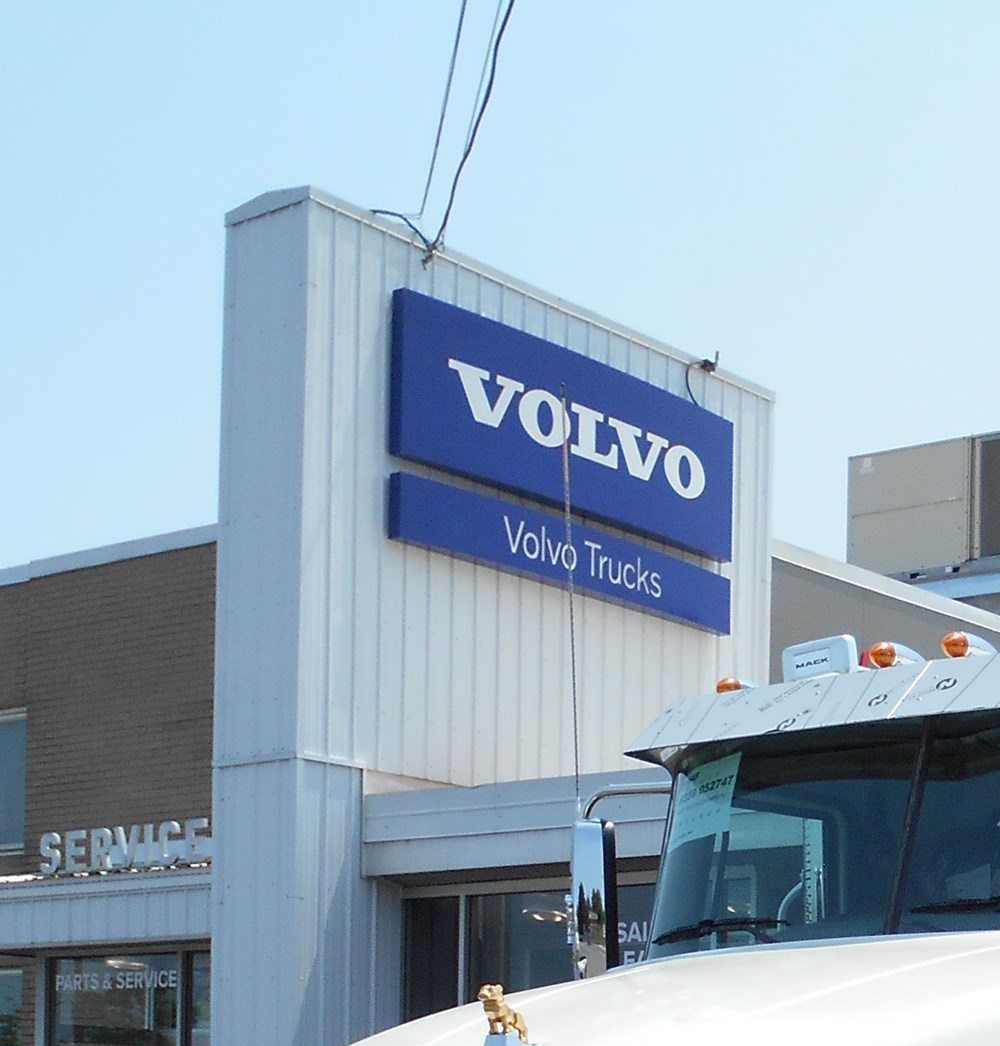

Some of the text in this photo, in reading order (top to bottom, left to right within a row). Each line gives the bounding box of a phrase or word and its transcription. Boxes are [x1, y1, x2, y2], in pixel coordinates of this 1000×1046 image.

[448, 358, 706, 500] VOLVO
[503, 515, 662, 598] Volvo Trucks
[795, 656, 829, 669] MACK
[40, 817, 211, 875] SERVICE
[55, 969, 178, 991] PARTS & SERVICE
